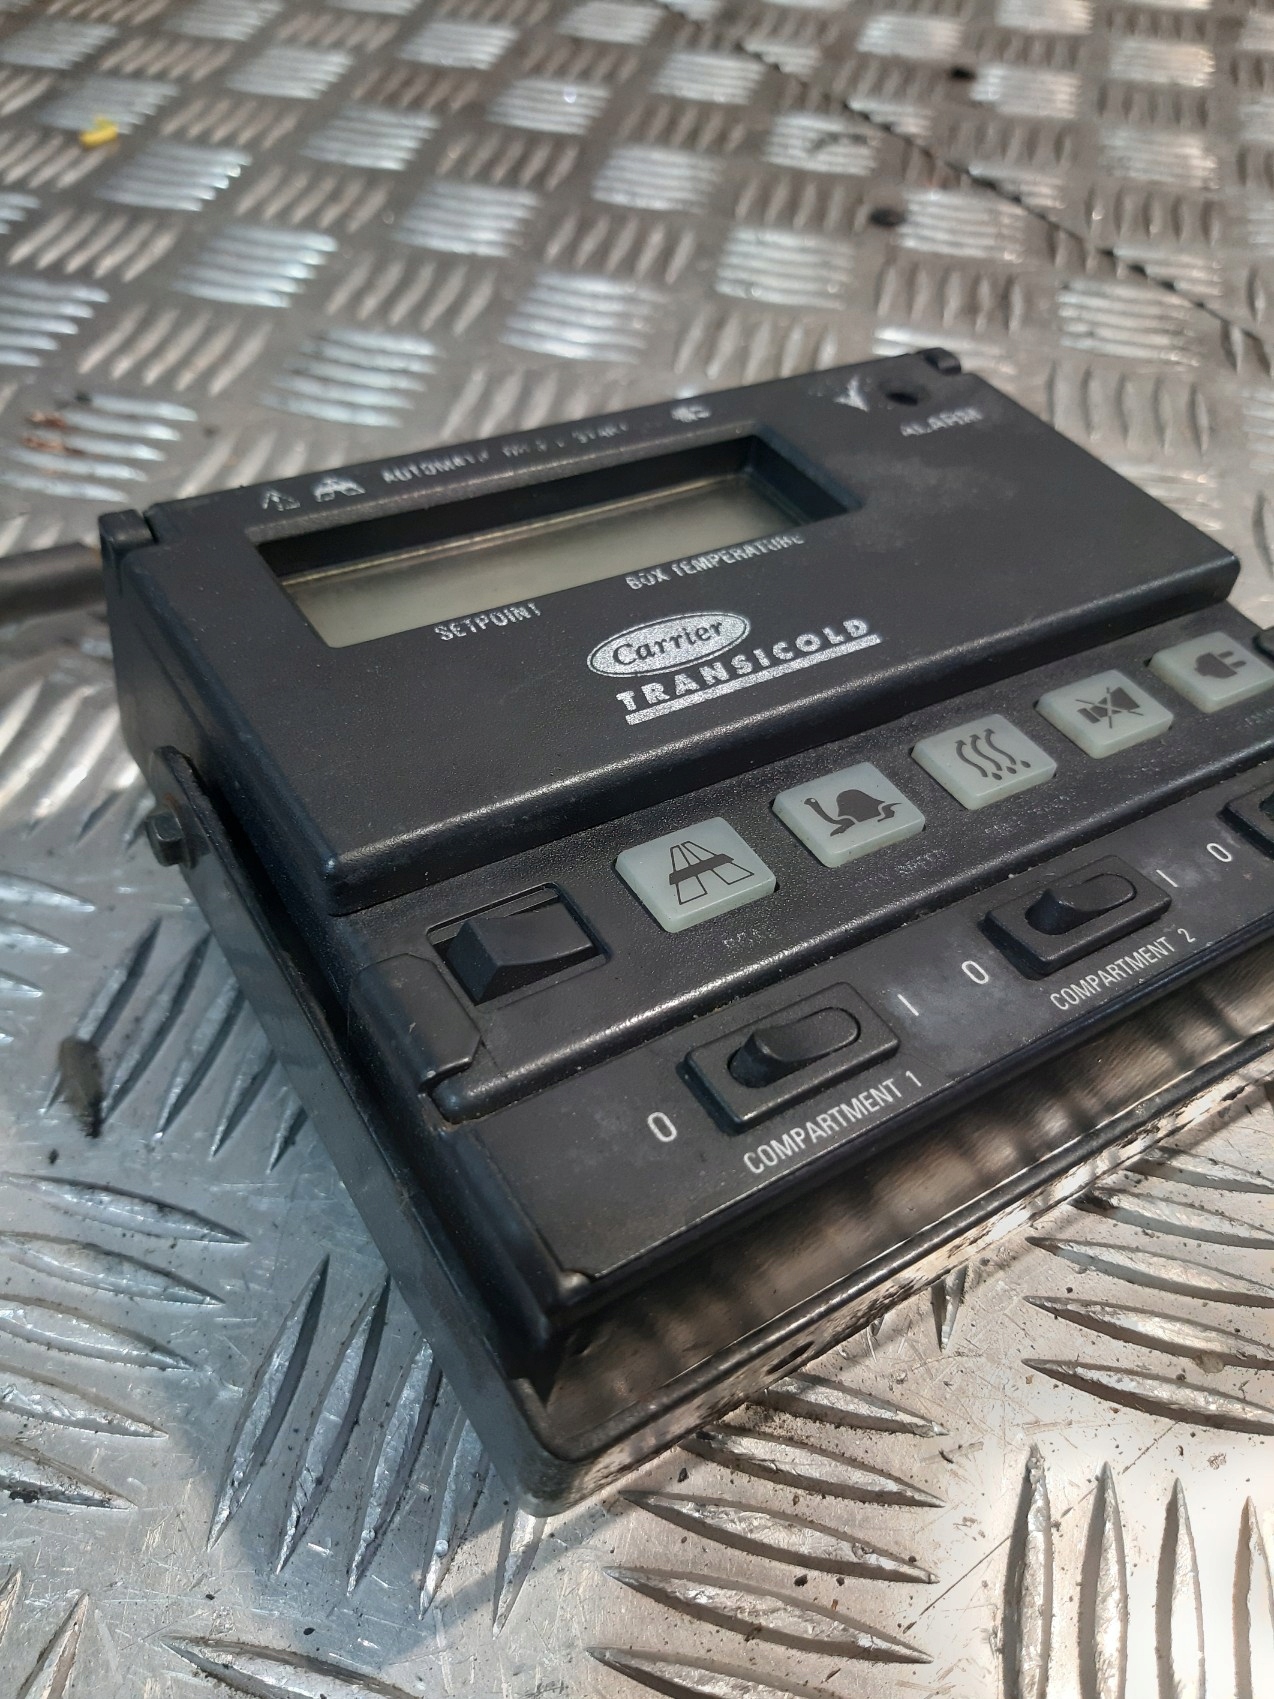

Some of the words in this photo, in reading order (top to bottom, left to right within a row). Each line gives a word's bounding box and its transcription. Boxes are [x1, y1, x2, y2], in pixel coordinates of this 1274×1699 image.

[625, 571, 671, 590] BOX
[672, 533, 805, 577] TEMPERATURE
[434, 601, 541, 641] SETPOINT
[611, 618, 724, 667] Carrier
[616, 618, 870, 711] TRANSICOLD
[1050, 936, 1176, 1011] COMPARTMENT
[1177, 927, 1197, 944] 2
[743, 1078, 903, 1175] COMPARTMENT
[904, 1070, 923, 1088] 1
